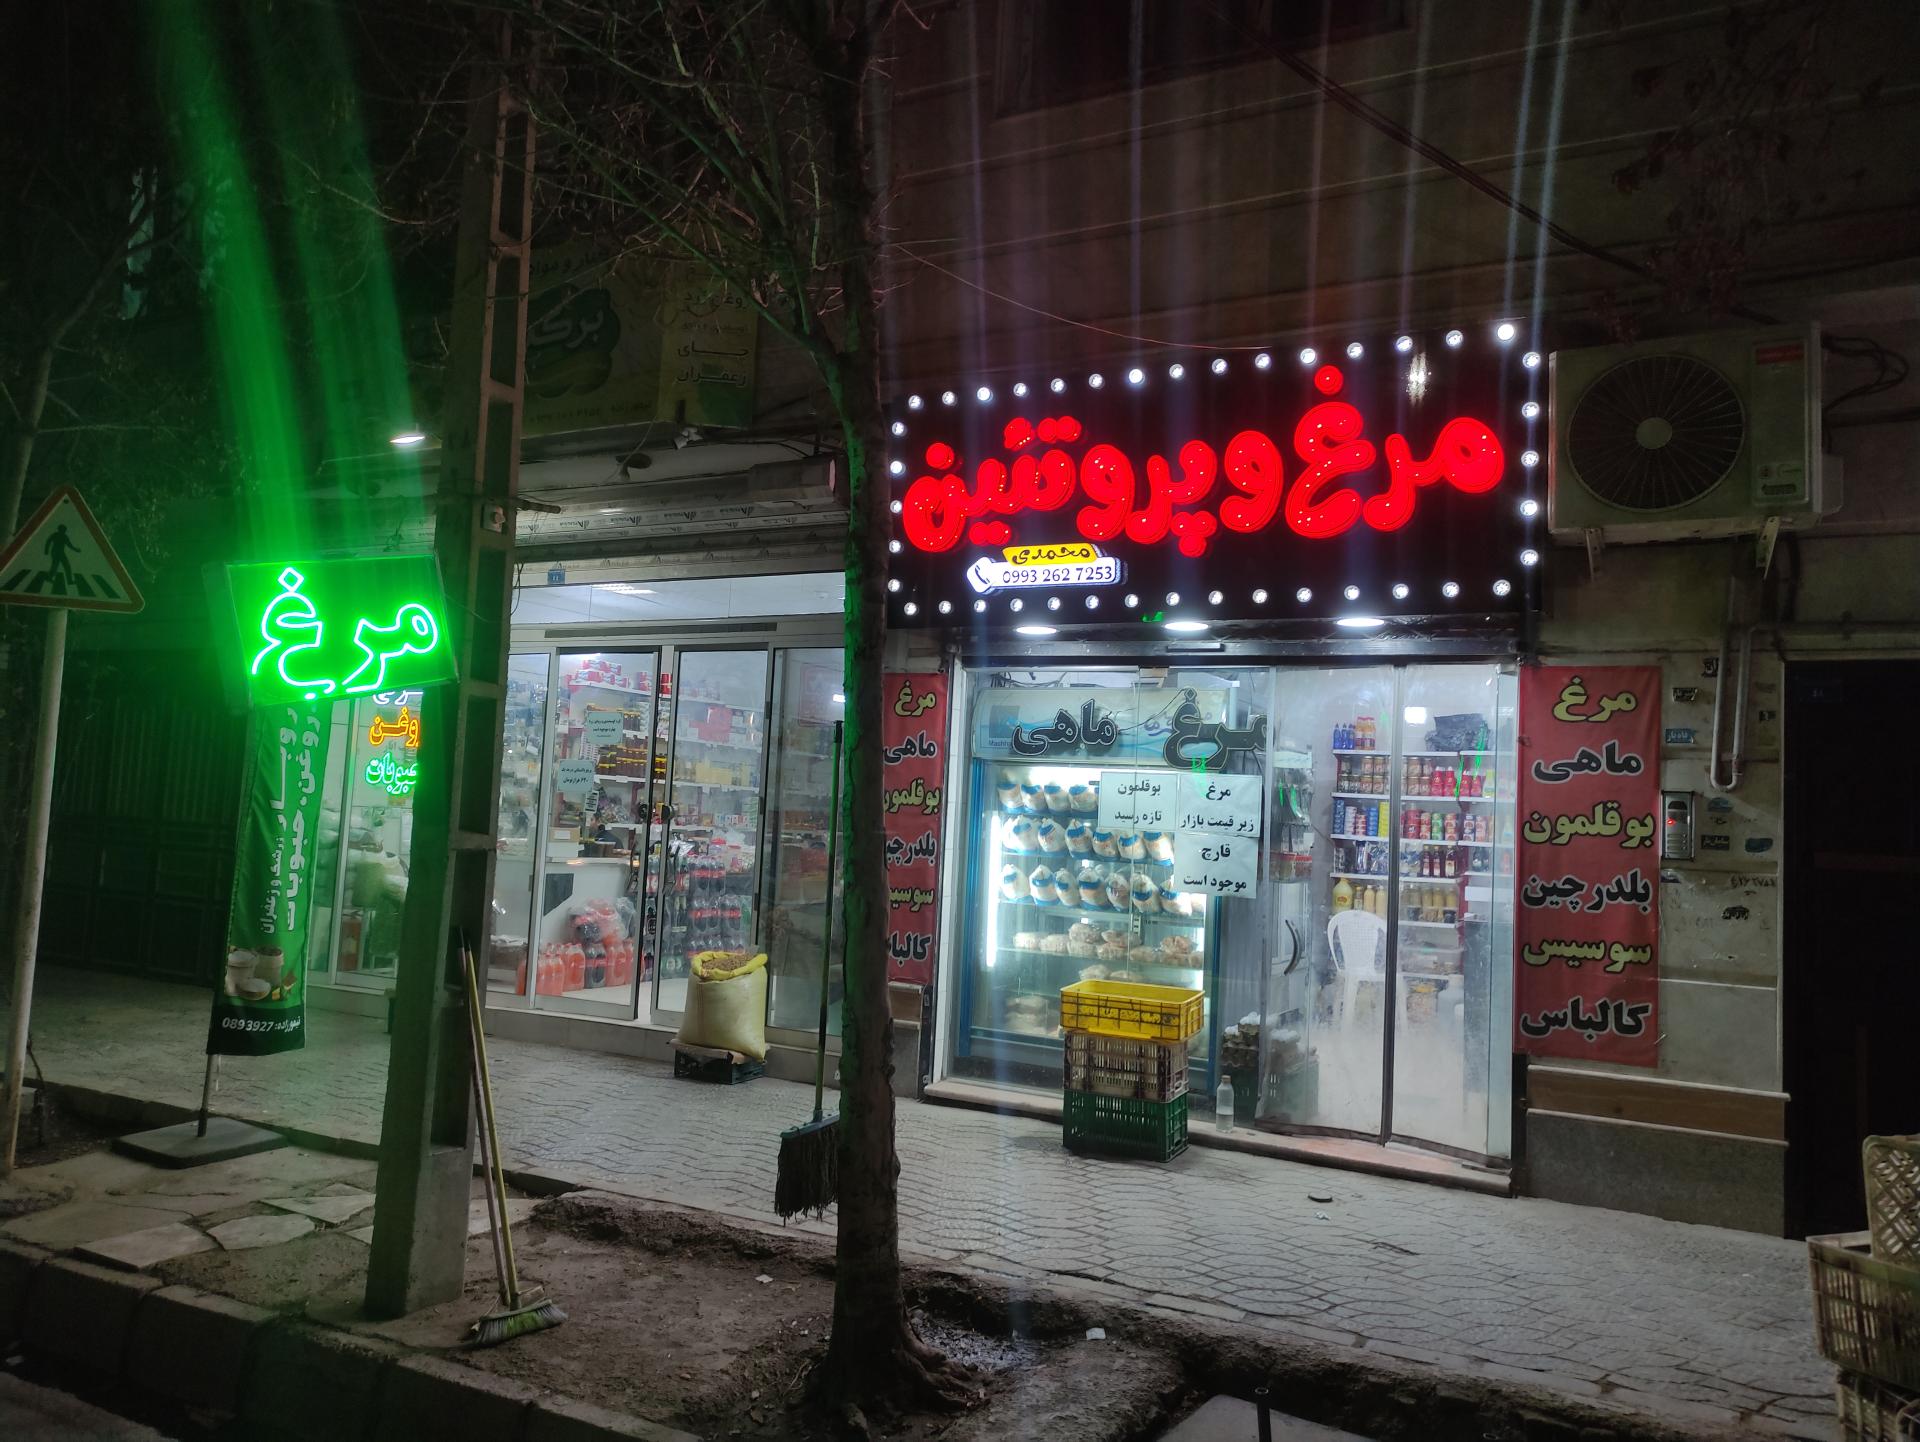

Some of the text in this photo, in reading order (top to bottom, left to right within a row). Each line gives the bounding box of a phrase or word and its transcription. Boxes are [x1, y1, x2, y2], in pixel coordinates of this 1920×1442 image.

[1286, 364, 1503, 540] مرغ
[1220, 430, 1286, 534] و
[1011, 546, 1091, 565] محمدی
[1002, 566, 1113, 584] 0993 262 7253
[251, 567, 438, 698] مرغ
[893, 680, 936, 717] مرغ
[1552, 675, 1638, 723] مرغ
[369, 706, 419, 748] وغن
[1011, 687, 1270, 769] مرغ ماهی
[883, 730, 938, 765] ماهی
[1531, 739, 1643, 783] ماهی
[268, 707, 298, 833] روبار
[1117, 779, 1161, 796] بوقلمون
[1205, 781, 1231, 800] مرغ
[285, 715, 321, 932] روغن حبوبات
[1115, 810, 1162, 825] تازه رسید
[1180, 815, 1255, 832] زیر قیمت بازار
[1522, 801, 1655, 849] بوقلمون
[269, 837, 285, 877] زرشک
[885, 831, 936, 865] بلدرچی
[1201, 843, 1231, 862] قارچ
[889, 887, 935, 912] سوسی
[1183, 875, 1247, 892] موجود است
[1522, 867, 1652, 915] بلدرچین
[259, 889, 281, 934] زعفران
[889, 931, 932, 967] کالبا
[1522, 937, 1652, 974] سوسیس
[1520, 996, 1651, 1041] کالباس
